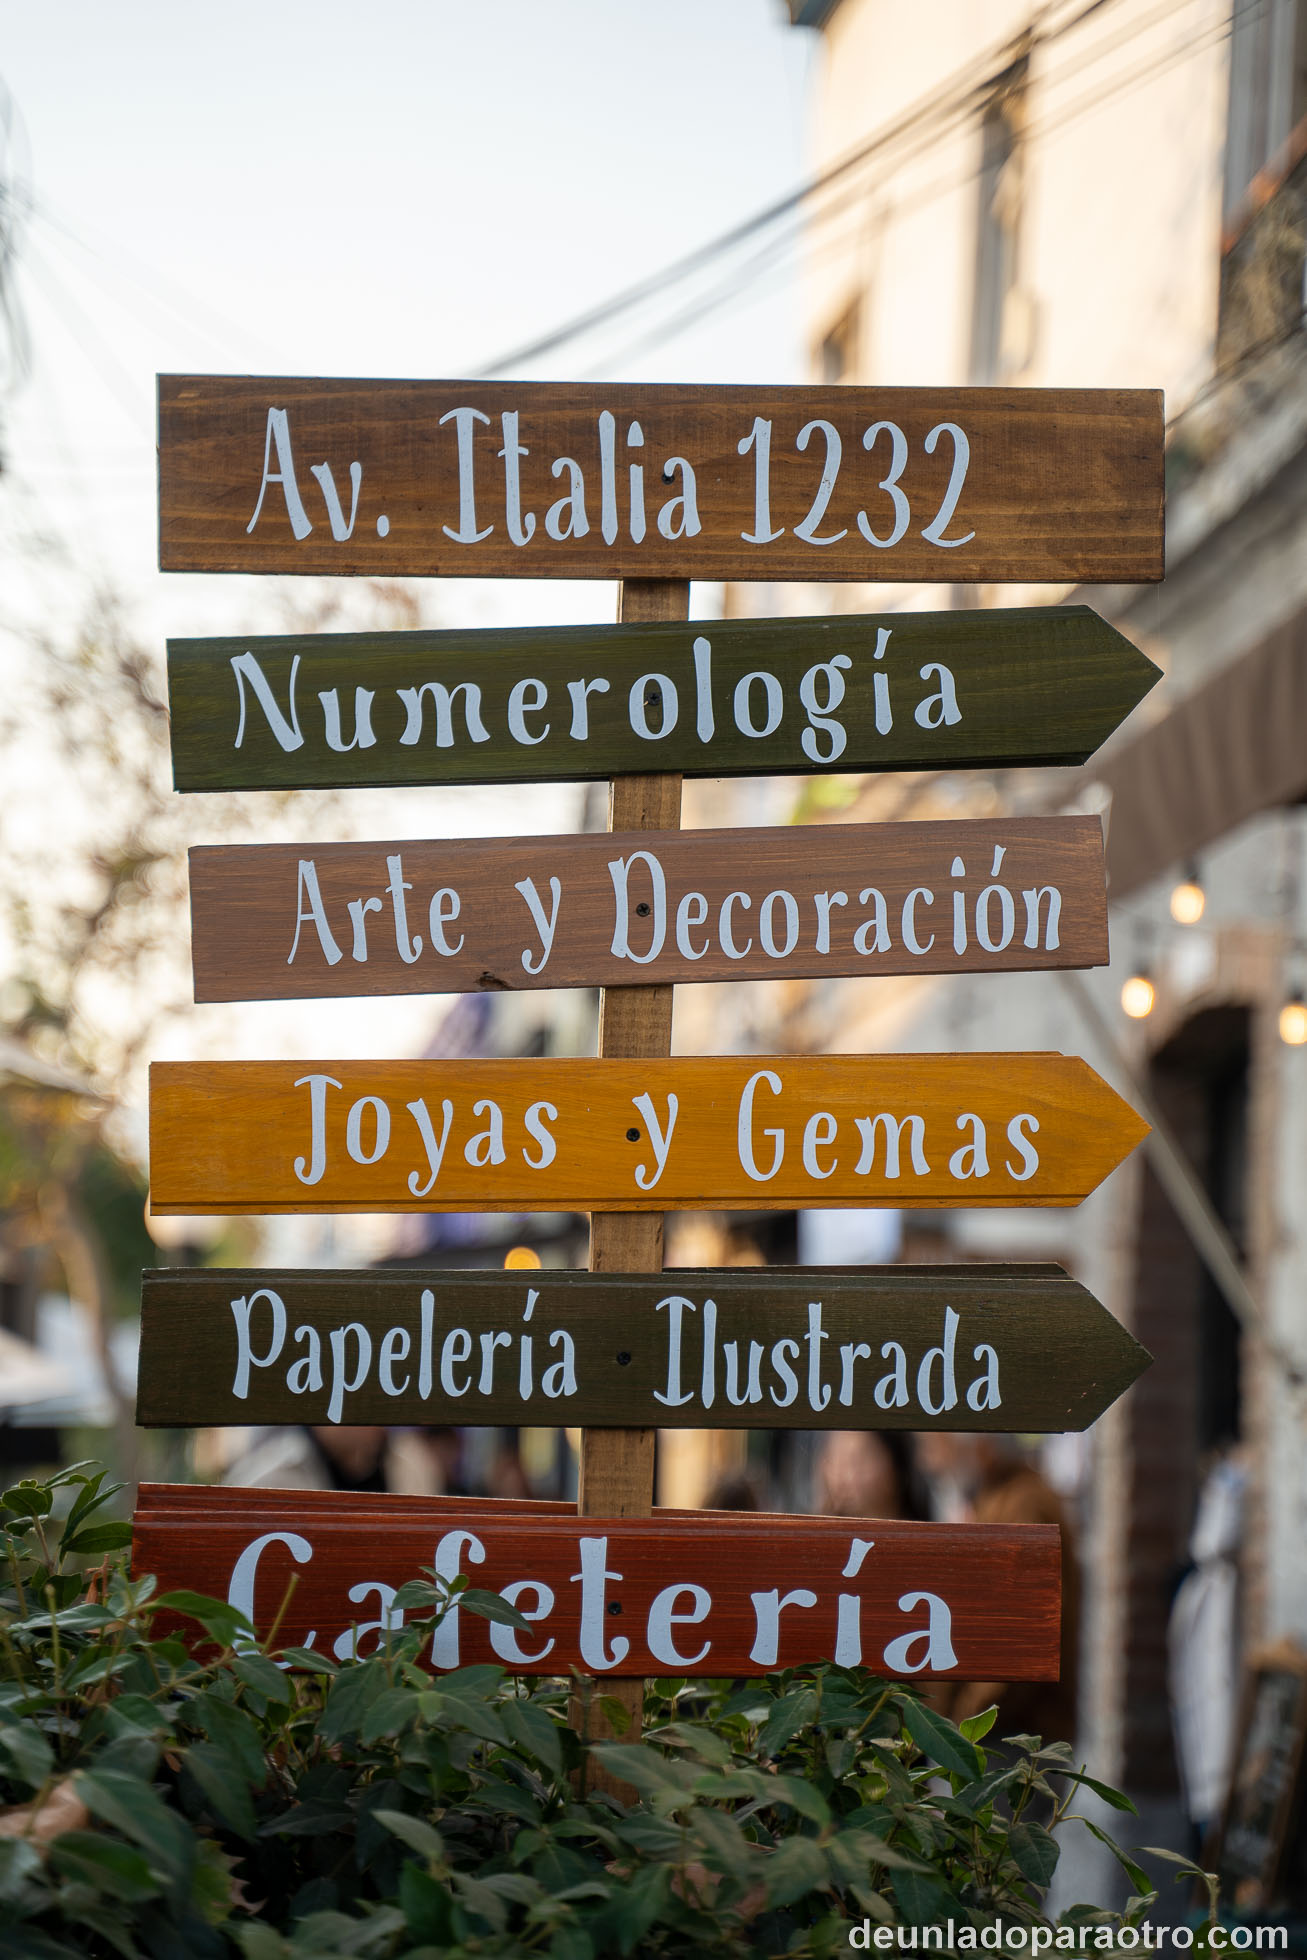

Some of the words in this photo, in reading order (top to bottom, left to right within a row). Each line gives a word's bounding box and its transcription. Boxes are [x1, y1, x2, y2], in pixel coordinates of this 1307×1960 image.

[246, 406, 390, 542] Av.
[438, 407, 702, 547] Italia
[737, 416, 976, 548] 1232
[230, 627, 963, 764] Numerología
[287, 853, 465, 966] Arte
[514, 876, 562, 975] y
[607, 844, 1063, 966] Decoración
[293, 1074, 558, 1197] Joyas
[631, 1091, 679, 1191] y
[737, 1070, 1040, 1182] Gemas
[230, 1288, 578, 1424] Papelería
[653, 1296, 1002, 1416] Ilustrada
[228, 1530, 959, 1674] Cafetería
